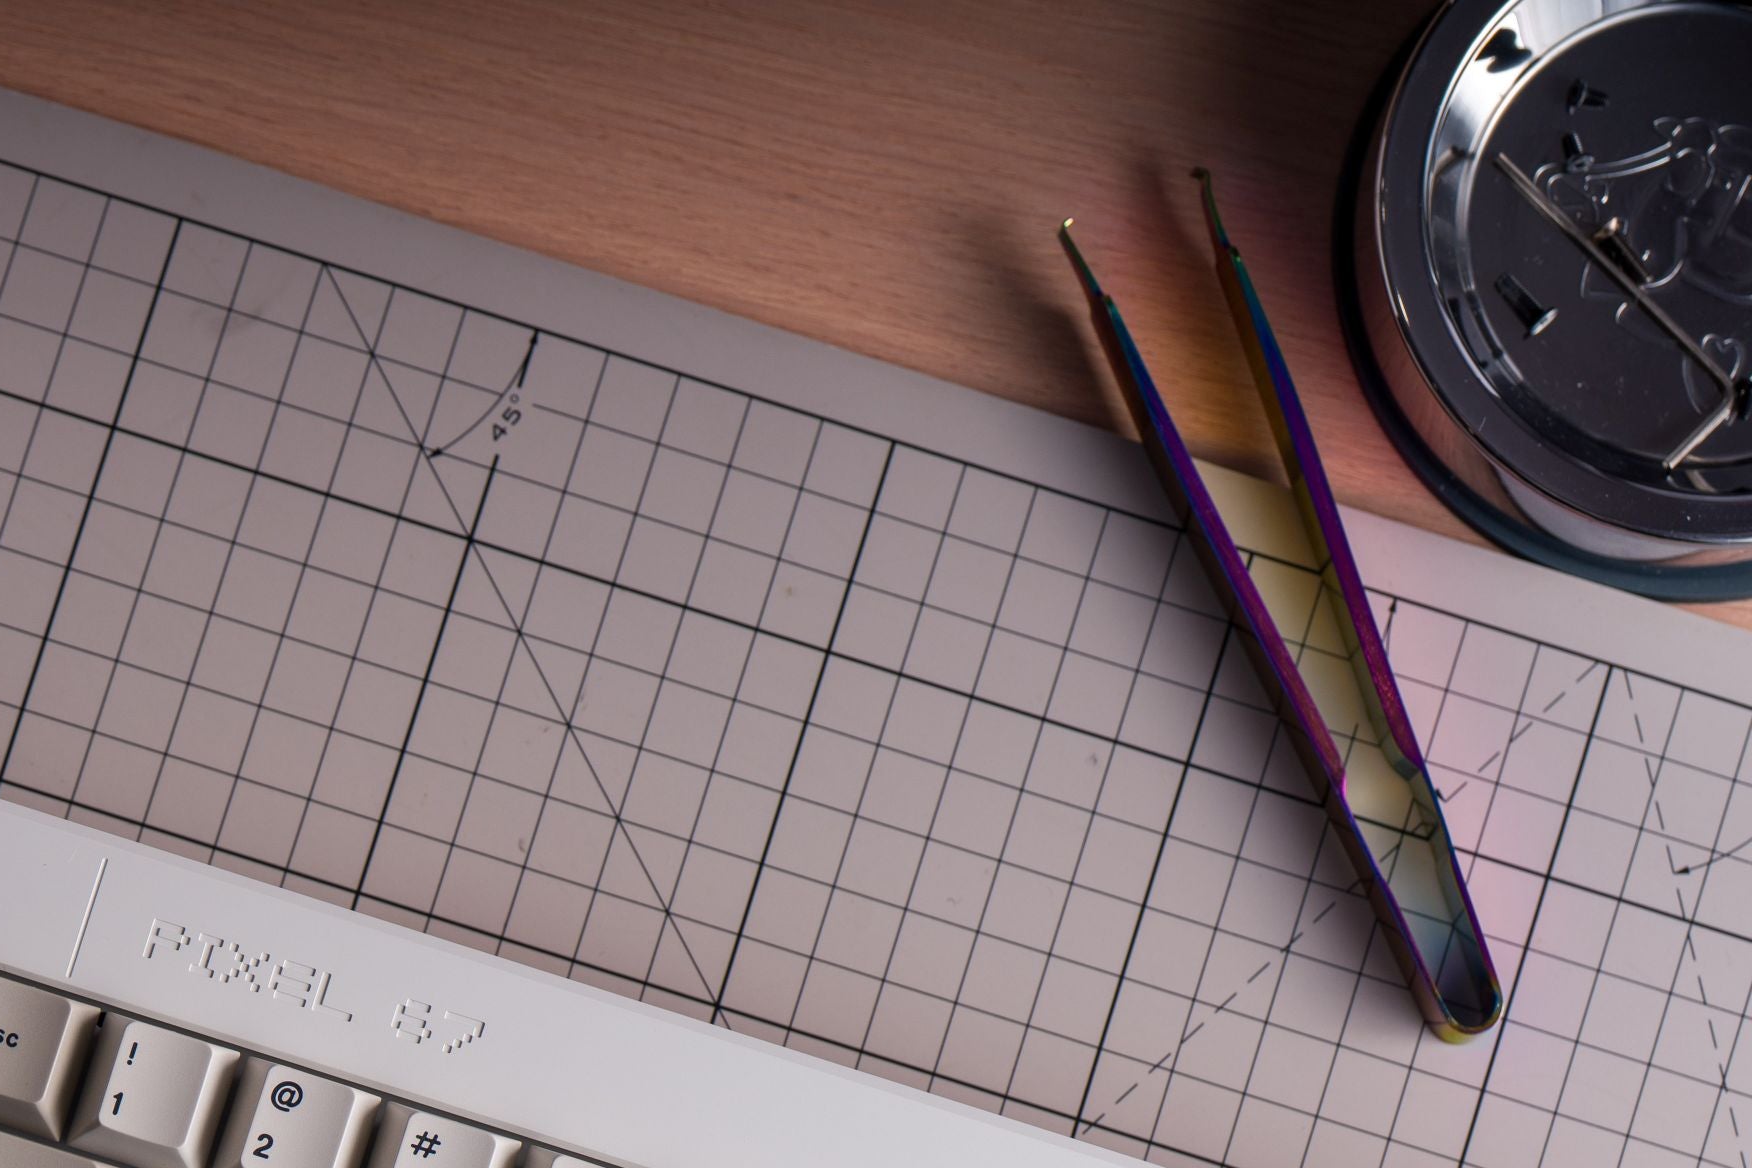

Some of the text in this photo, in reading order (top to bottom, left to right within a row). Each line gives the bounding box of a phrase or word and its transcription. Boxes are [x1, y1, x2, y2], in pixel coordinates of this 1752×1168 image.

[142, 918, 486, 1054] PIXEL 67
[126, 1042, 138, 1066] !
[112, 1092, 124, 1116] 1
[270, 1081, 304, 1112] @
[252, 1133, 274, 1159] 2
[410, 1131, 442, 1158] #
